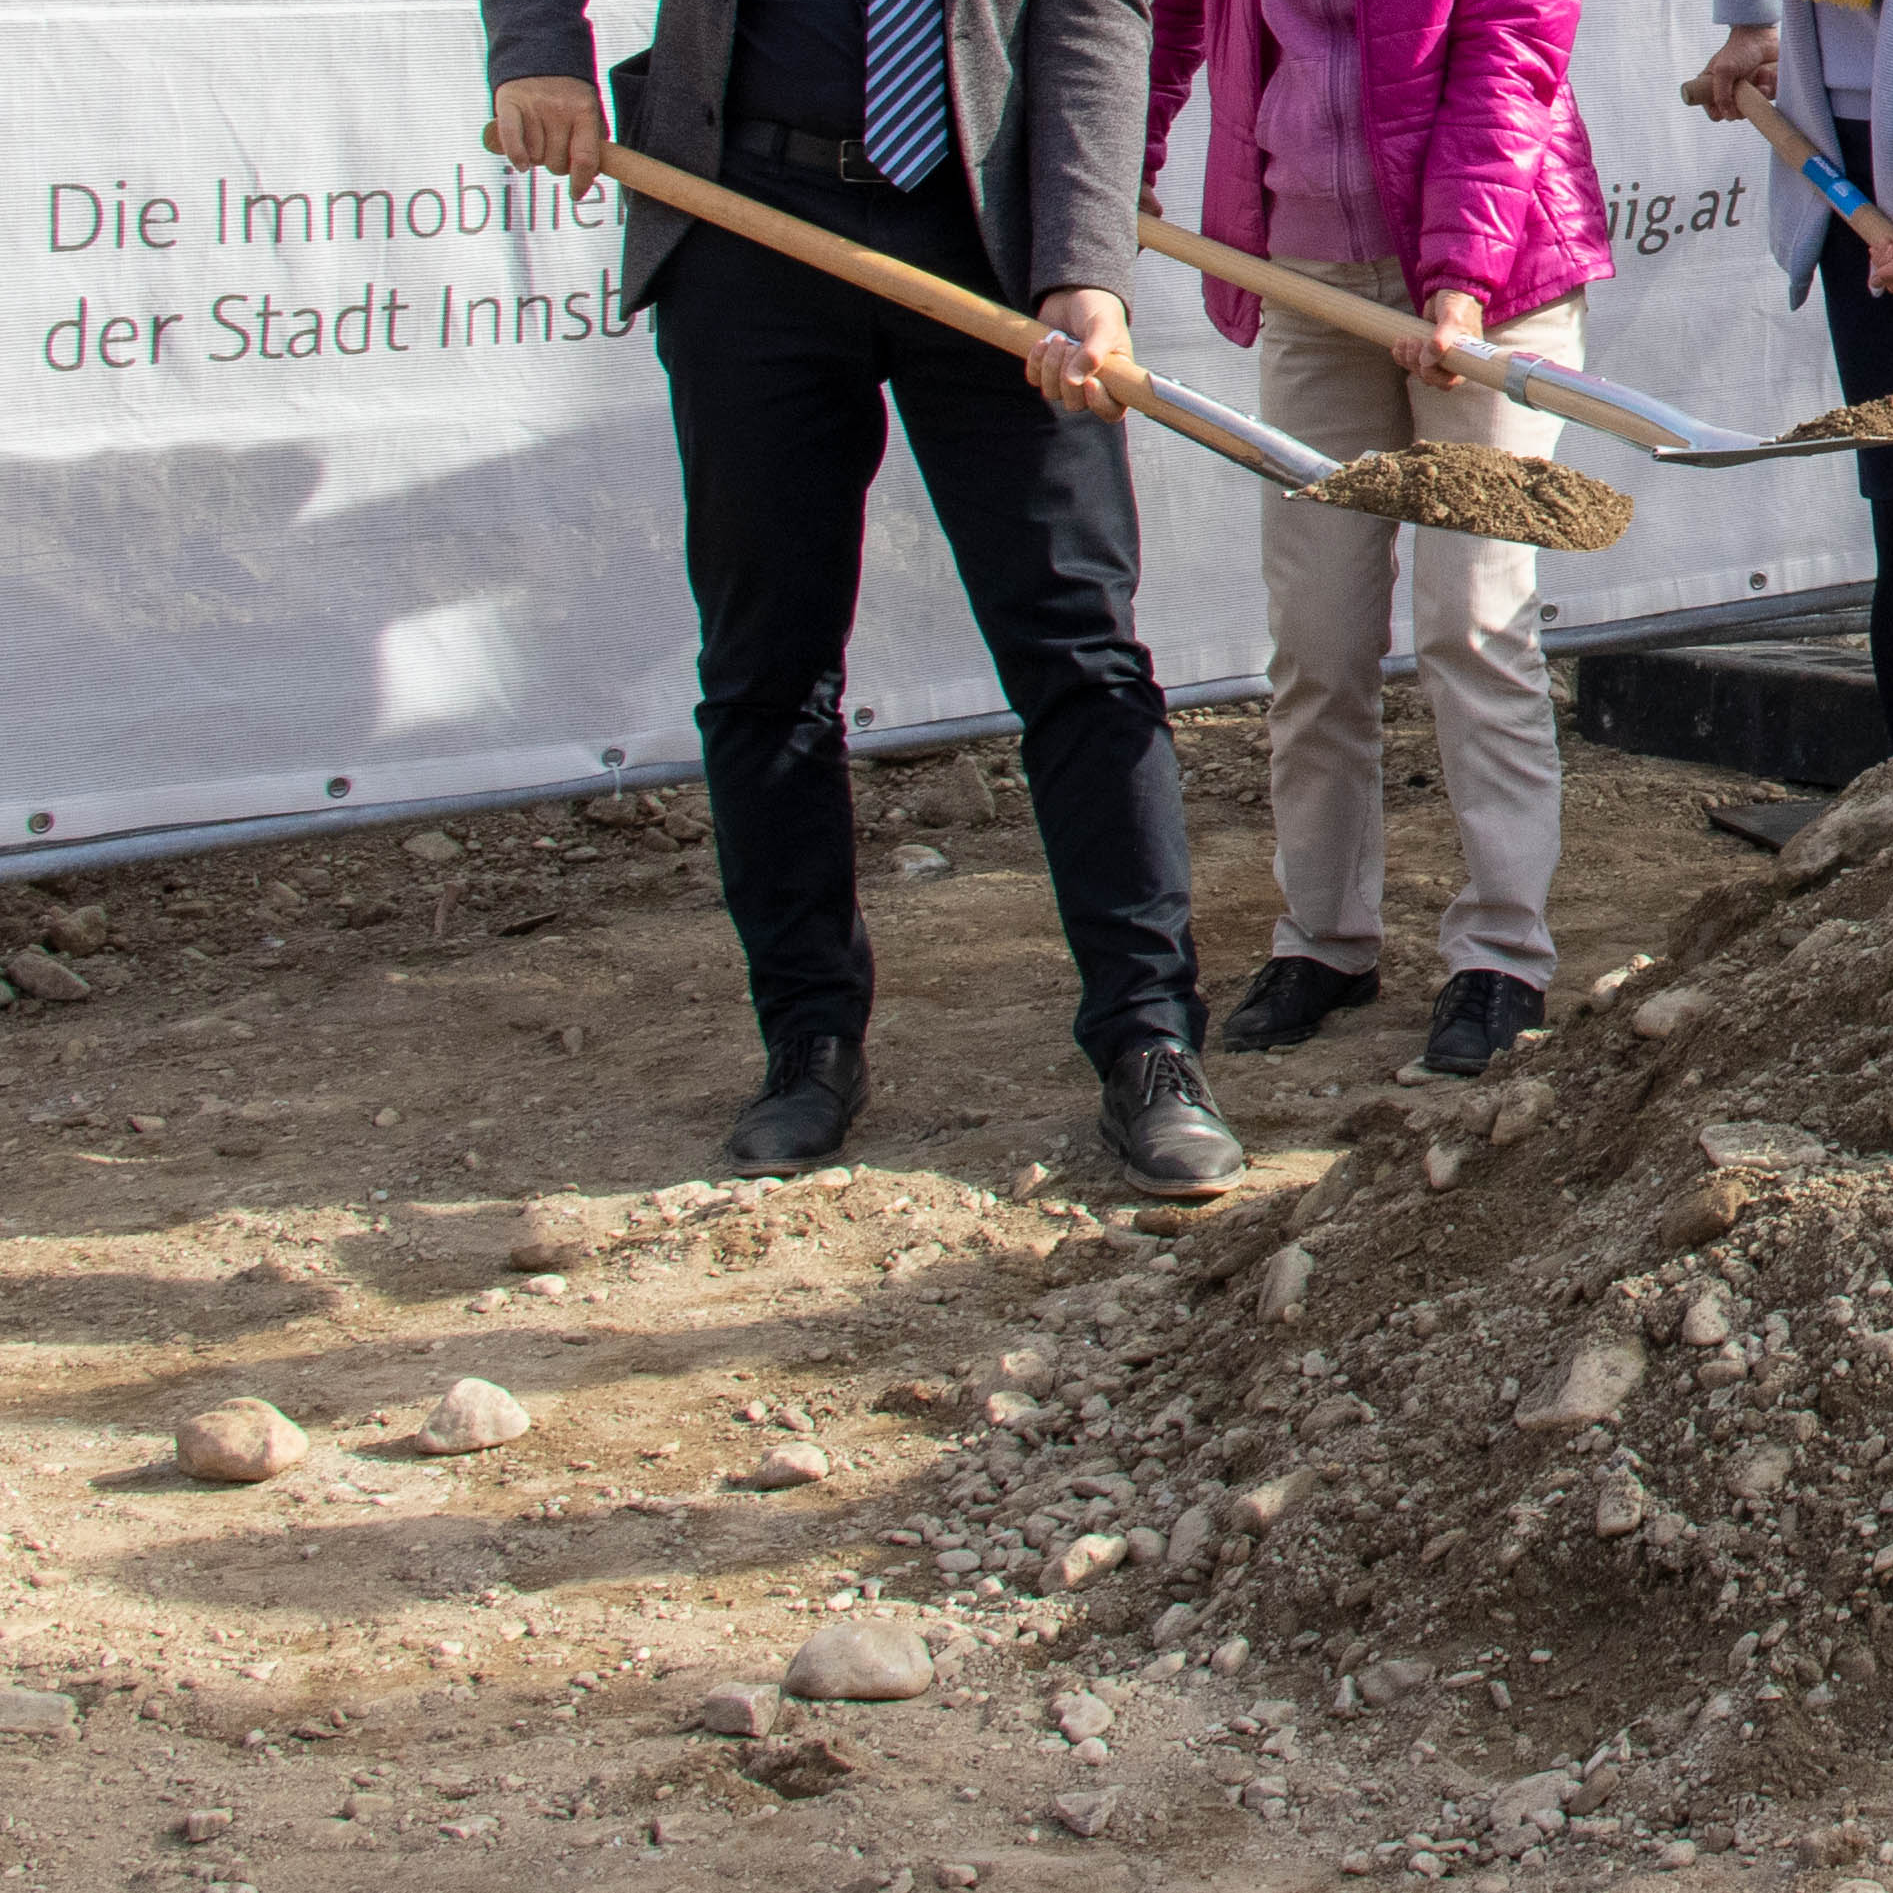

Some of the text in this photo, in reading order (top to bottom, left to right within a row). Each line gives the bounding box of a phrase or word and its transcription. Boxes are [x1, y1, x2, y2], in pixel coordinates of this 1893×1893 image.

[49, 179, 181, 254] Die
[1608, 176, 1747, 255] iig.at
[44, 297, 182, 372] der
[208, 282, 410, 363] Stadt
